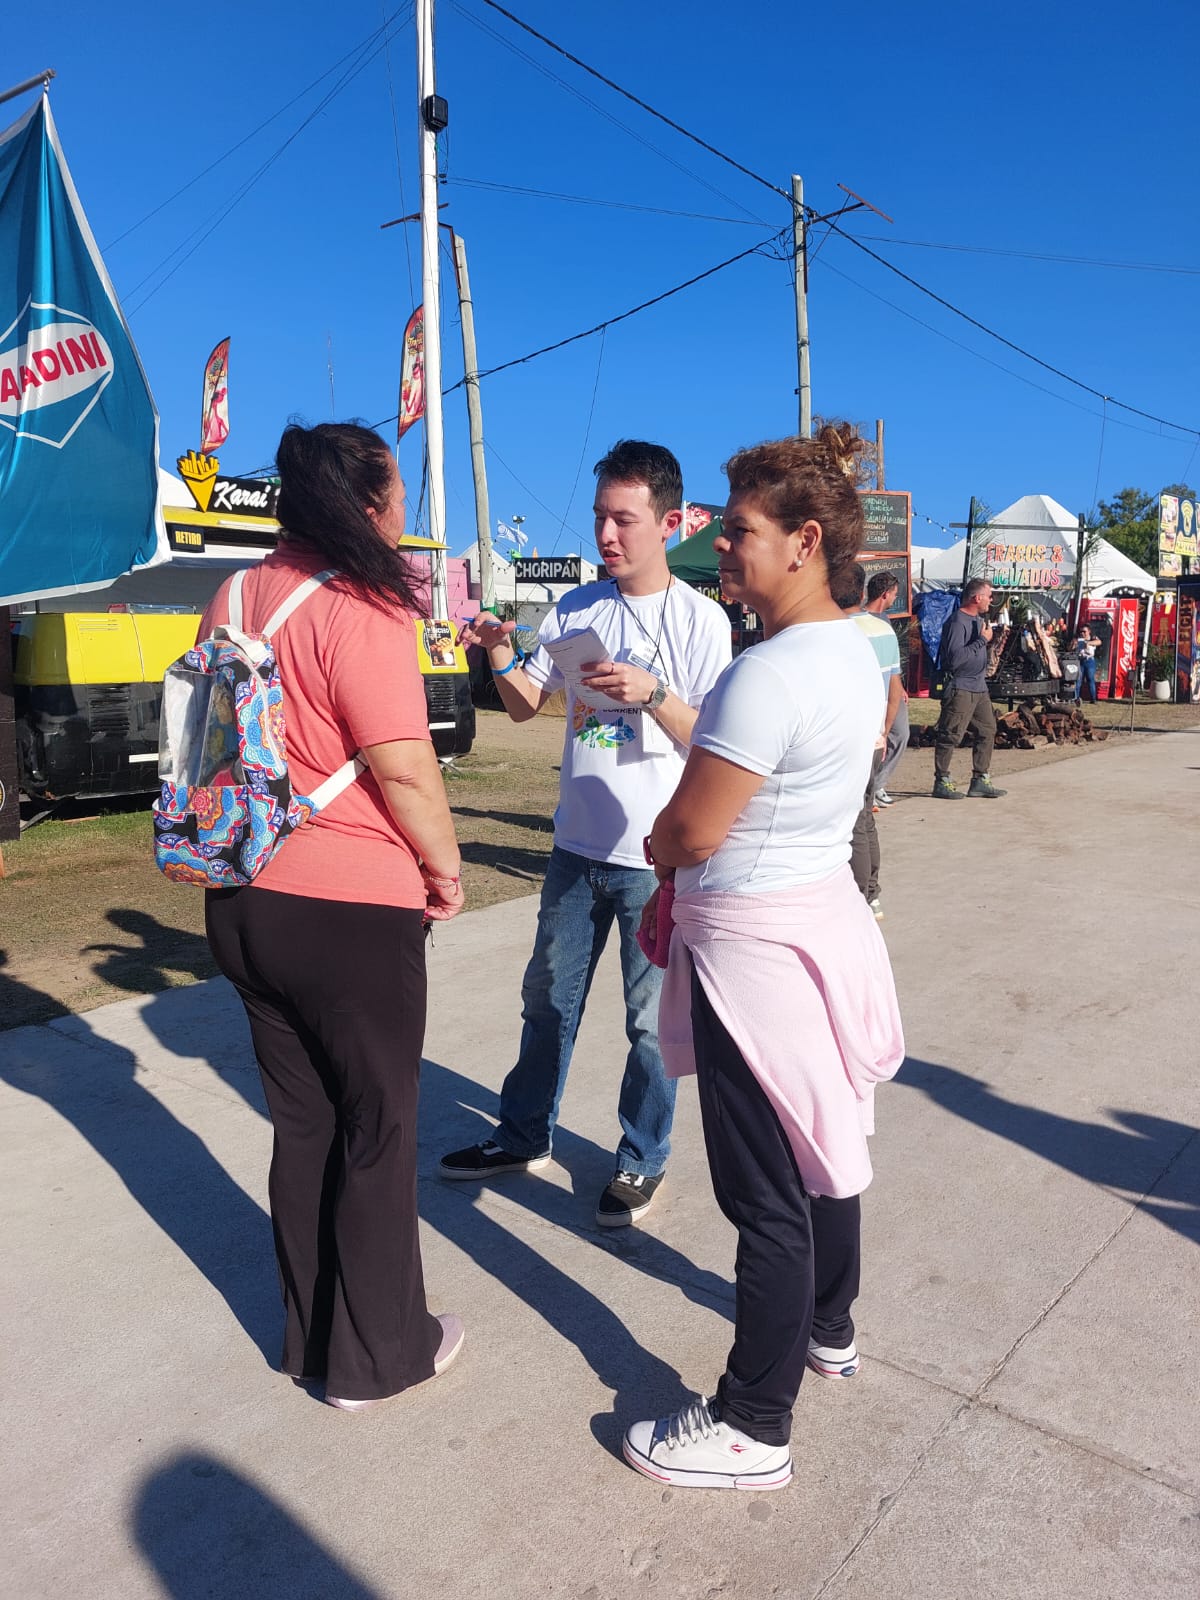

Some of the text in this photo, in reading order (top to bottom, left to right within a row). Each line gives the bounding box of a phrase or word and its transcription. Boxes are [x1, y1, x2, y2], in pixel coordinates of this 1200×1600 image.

[213, 481, 271, 511] Karai
[175, 530, 202, 546] RETIRO
[1051, 544, 1064, 563] &
[515, 559, 580, 578] CHORIPÁN
[992, 567, 1061, 587] ICUADOS
